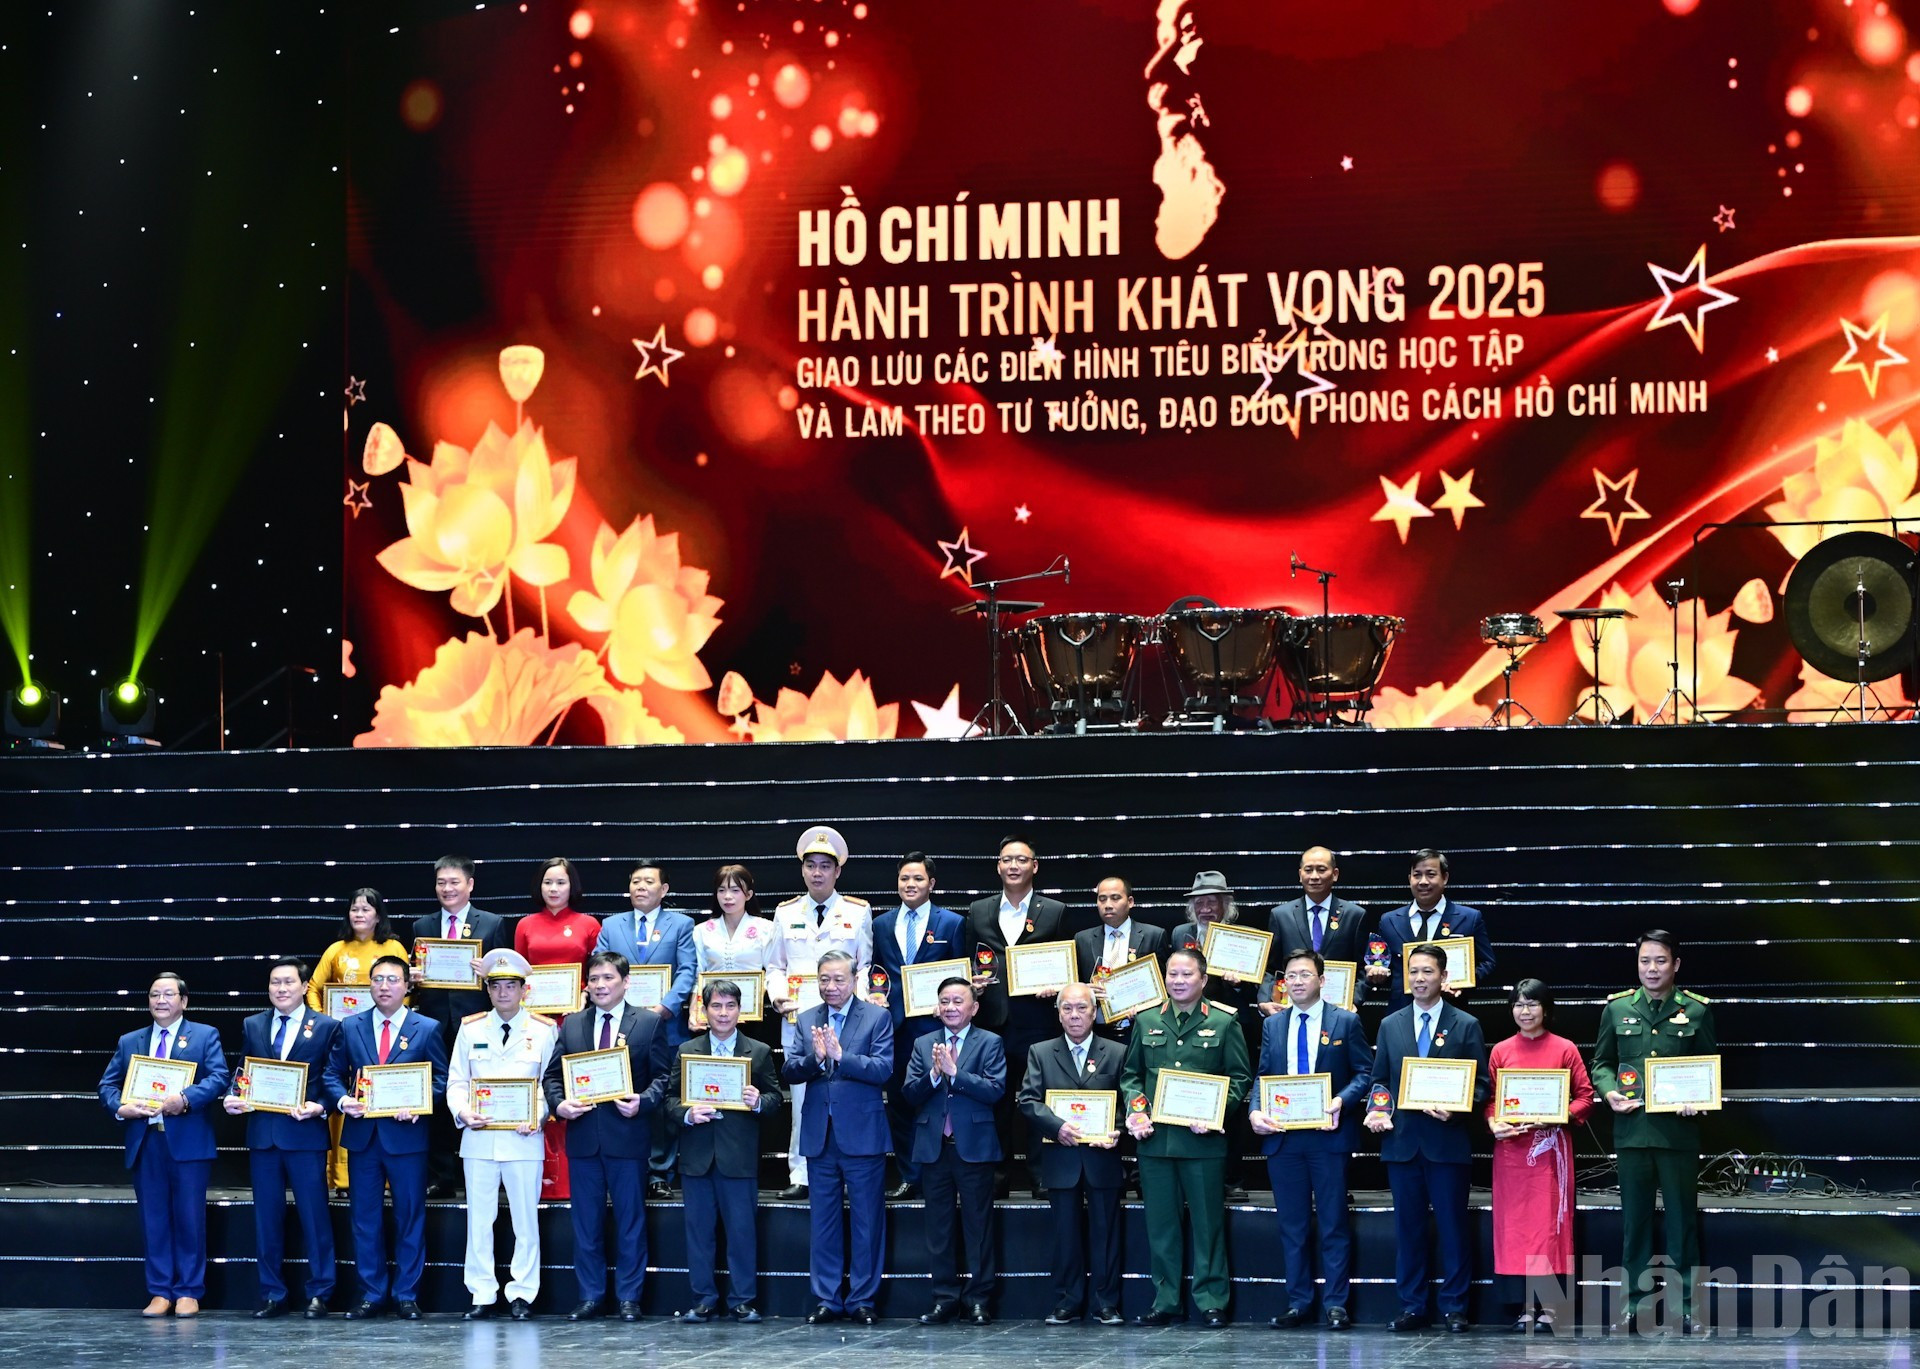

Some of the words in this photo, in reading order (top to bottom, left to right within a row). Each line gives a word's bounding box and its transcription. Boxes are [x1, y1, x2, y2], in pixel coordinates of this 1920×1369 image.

[798, 186, 867, 267] HỒ
[879, 191, 970, 264] CHÍ
[978, 198, 1120, 260] MINH
[798, 277, 929, 342] HÀNH
[949, 271, 1093, 337] TRÌNH
[1118, 264, 1248, 332] KHÁT
[1267, 267, 1405, 335] VỌNG
[1428, 262, 1546, 320] 2025
[797, 356, 860, 388] GIAO
[871, 351, 923, 386] LƯU
[934, 347, 989, 384] CÁC
[1074, 343, 1140, 380] HÌNH
[1150, 340, 1210, 377] TIÊU
[1296, 337, 1387, 374] TRONG
[1400, 336, 1457, 374] HỌC
[1467, 329, 1524, 373] TẬP
[797, 401, 833, 439] VÀ
[845, 403, 903, 438] LÀM
[915, 403, 986, 436] THEO
[997, 398, 1033, 433] TƯ
[1044, 390, 1147, 435] TƯỞNG,
[1159, 396, 1218, 434] ĐẠO
[1310, 390, 1409, 424] PHONG
[1422, 382, 1501, 421] CÁCH
[1515, 375, 1554, 417] HỒ
[1567, 377, 1617, 416] CHÍ
[1630, 380, 1708, 414] MINH
